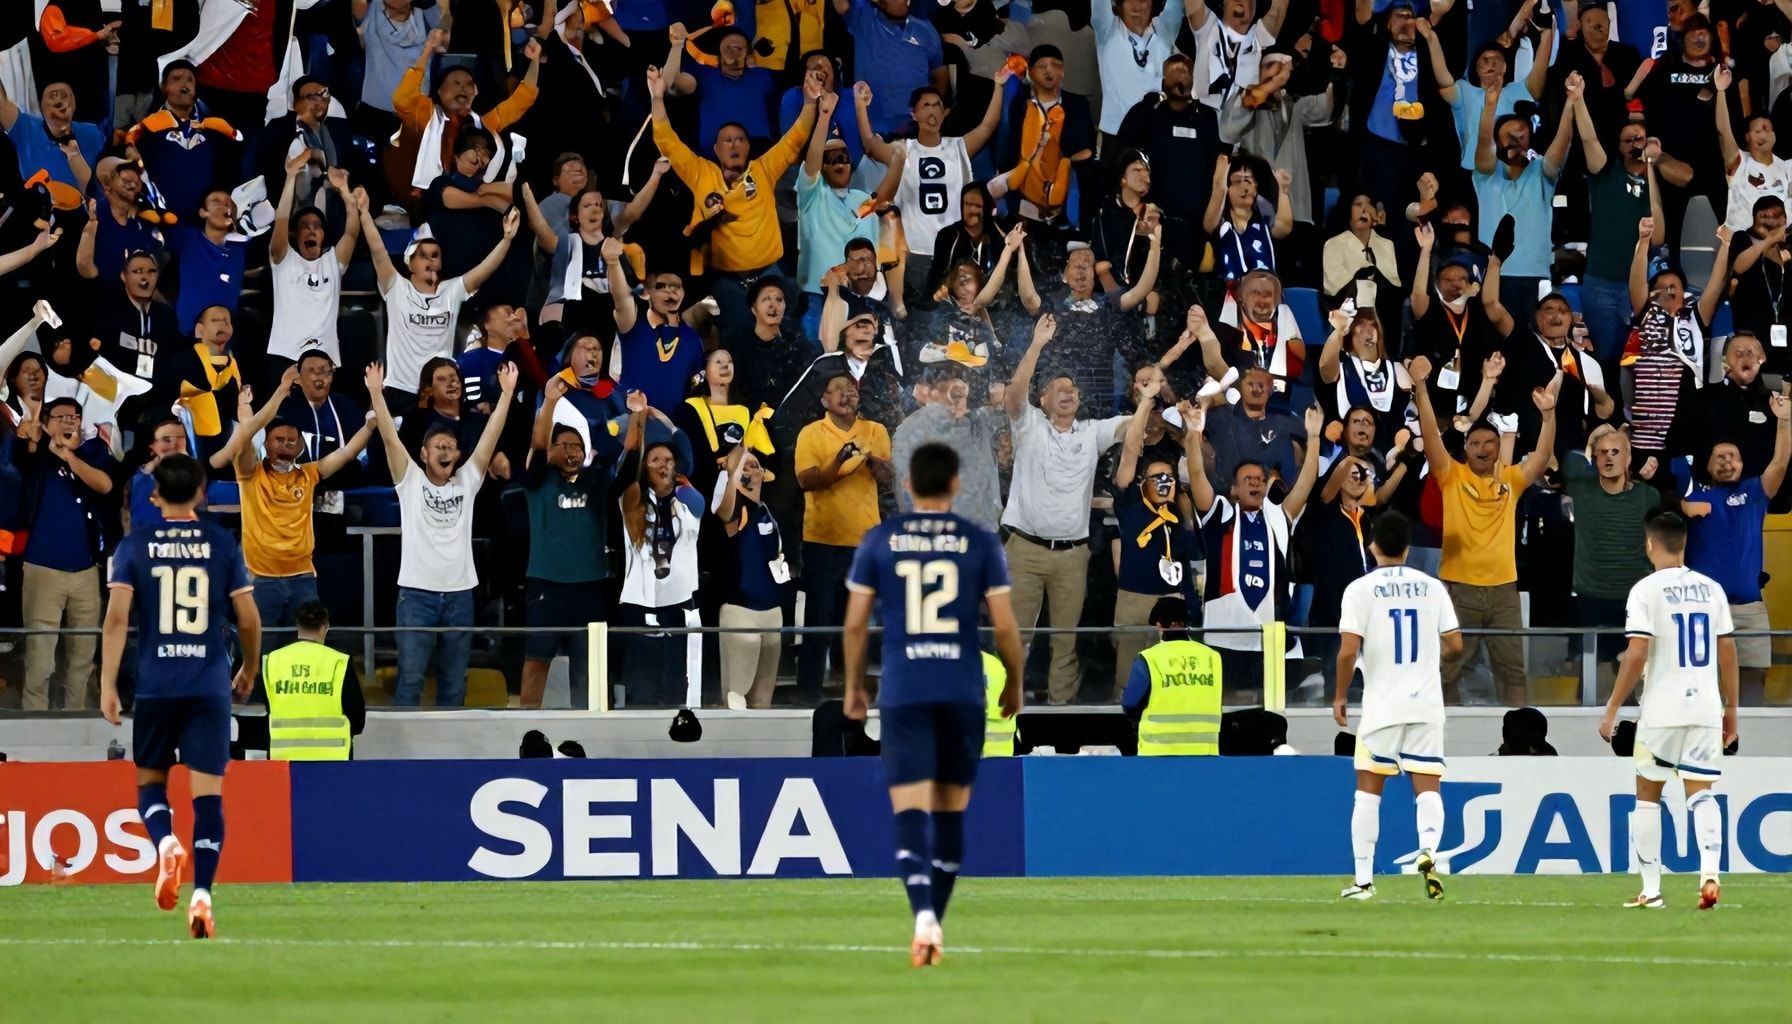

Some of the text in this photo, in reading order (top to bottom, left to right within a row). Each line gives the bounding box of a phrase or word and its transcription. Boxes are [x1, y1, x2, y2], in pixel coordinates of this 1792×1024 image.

[151, 566, 209, 635] 19
[895, 560, 959, 635] 12
[1389, 608, 1418, 665] 11
[1671, 612, 1710, 668] 10
[468, 777, 853, 878] SENA
